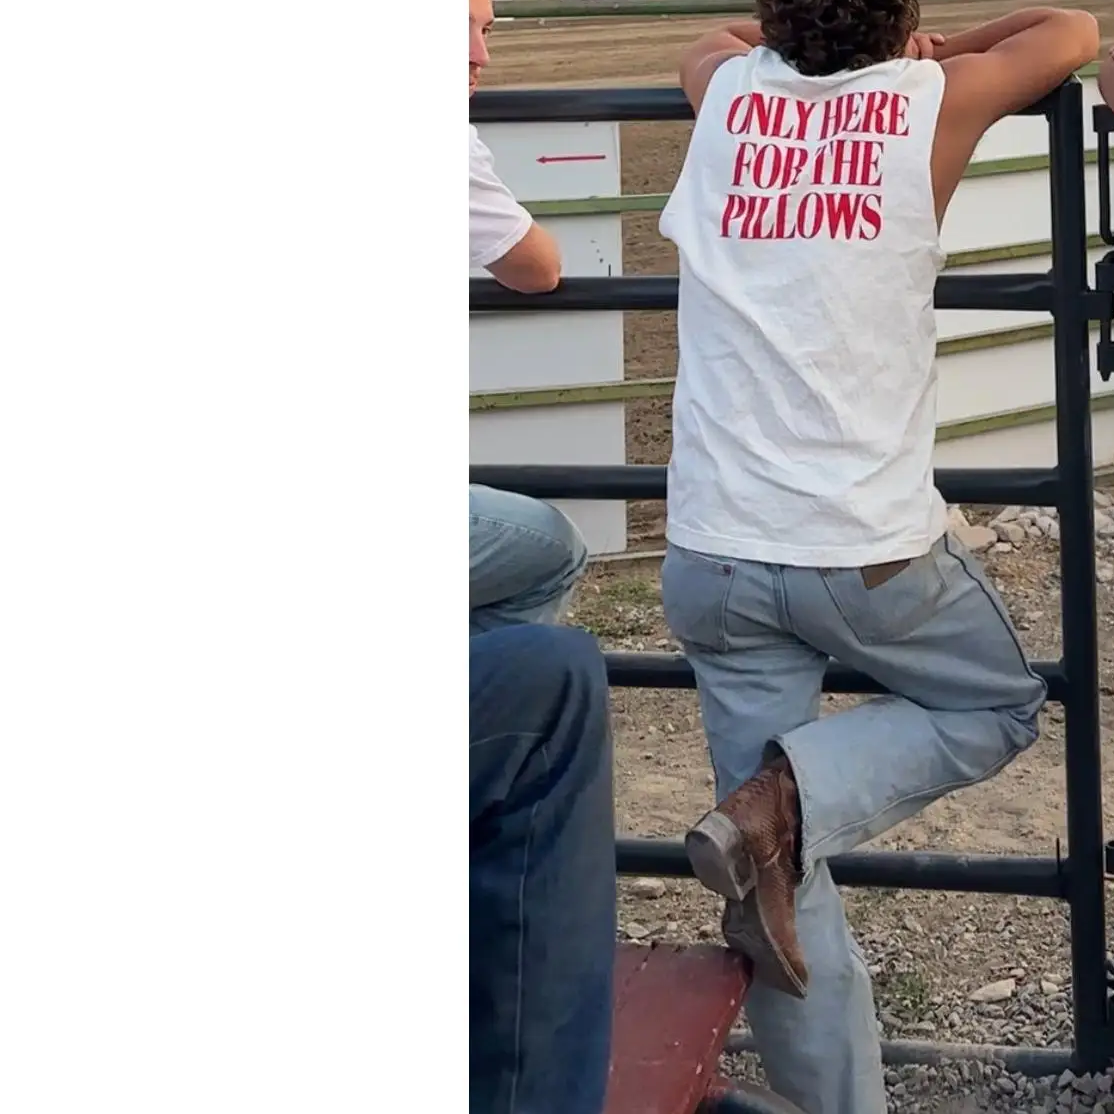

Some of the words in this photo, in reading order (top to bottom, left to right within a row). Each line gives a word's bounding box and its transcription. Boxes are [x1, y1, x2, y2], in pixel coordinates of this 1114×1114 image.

[727, 92, 817, 140] ONLY
[819, 90, 909, 140] HERE
[732, 141, 808, 189] FOR
[811, 140, 884, 186] THE
[720, 192, 882, 240] PILLOWS
